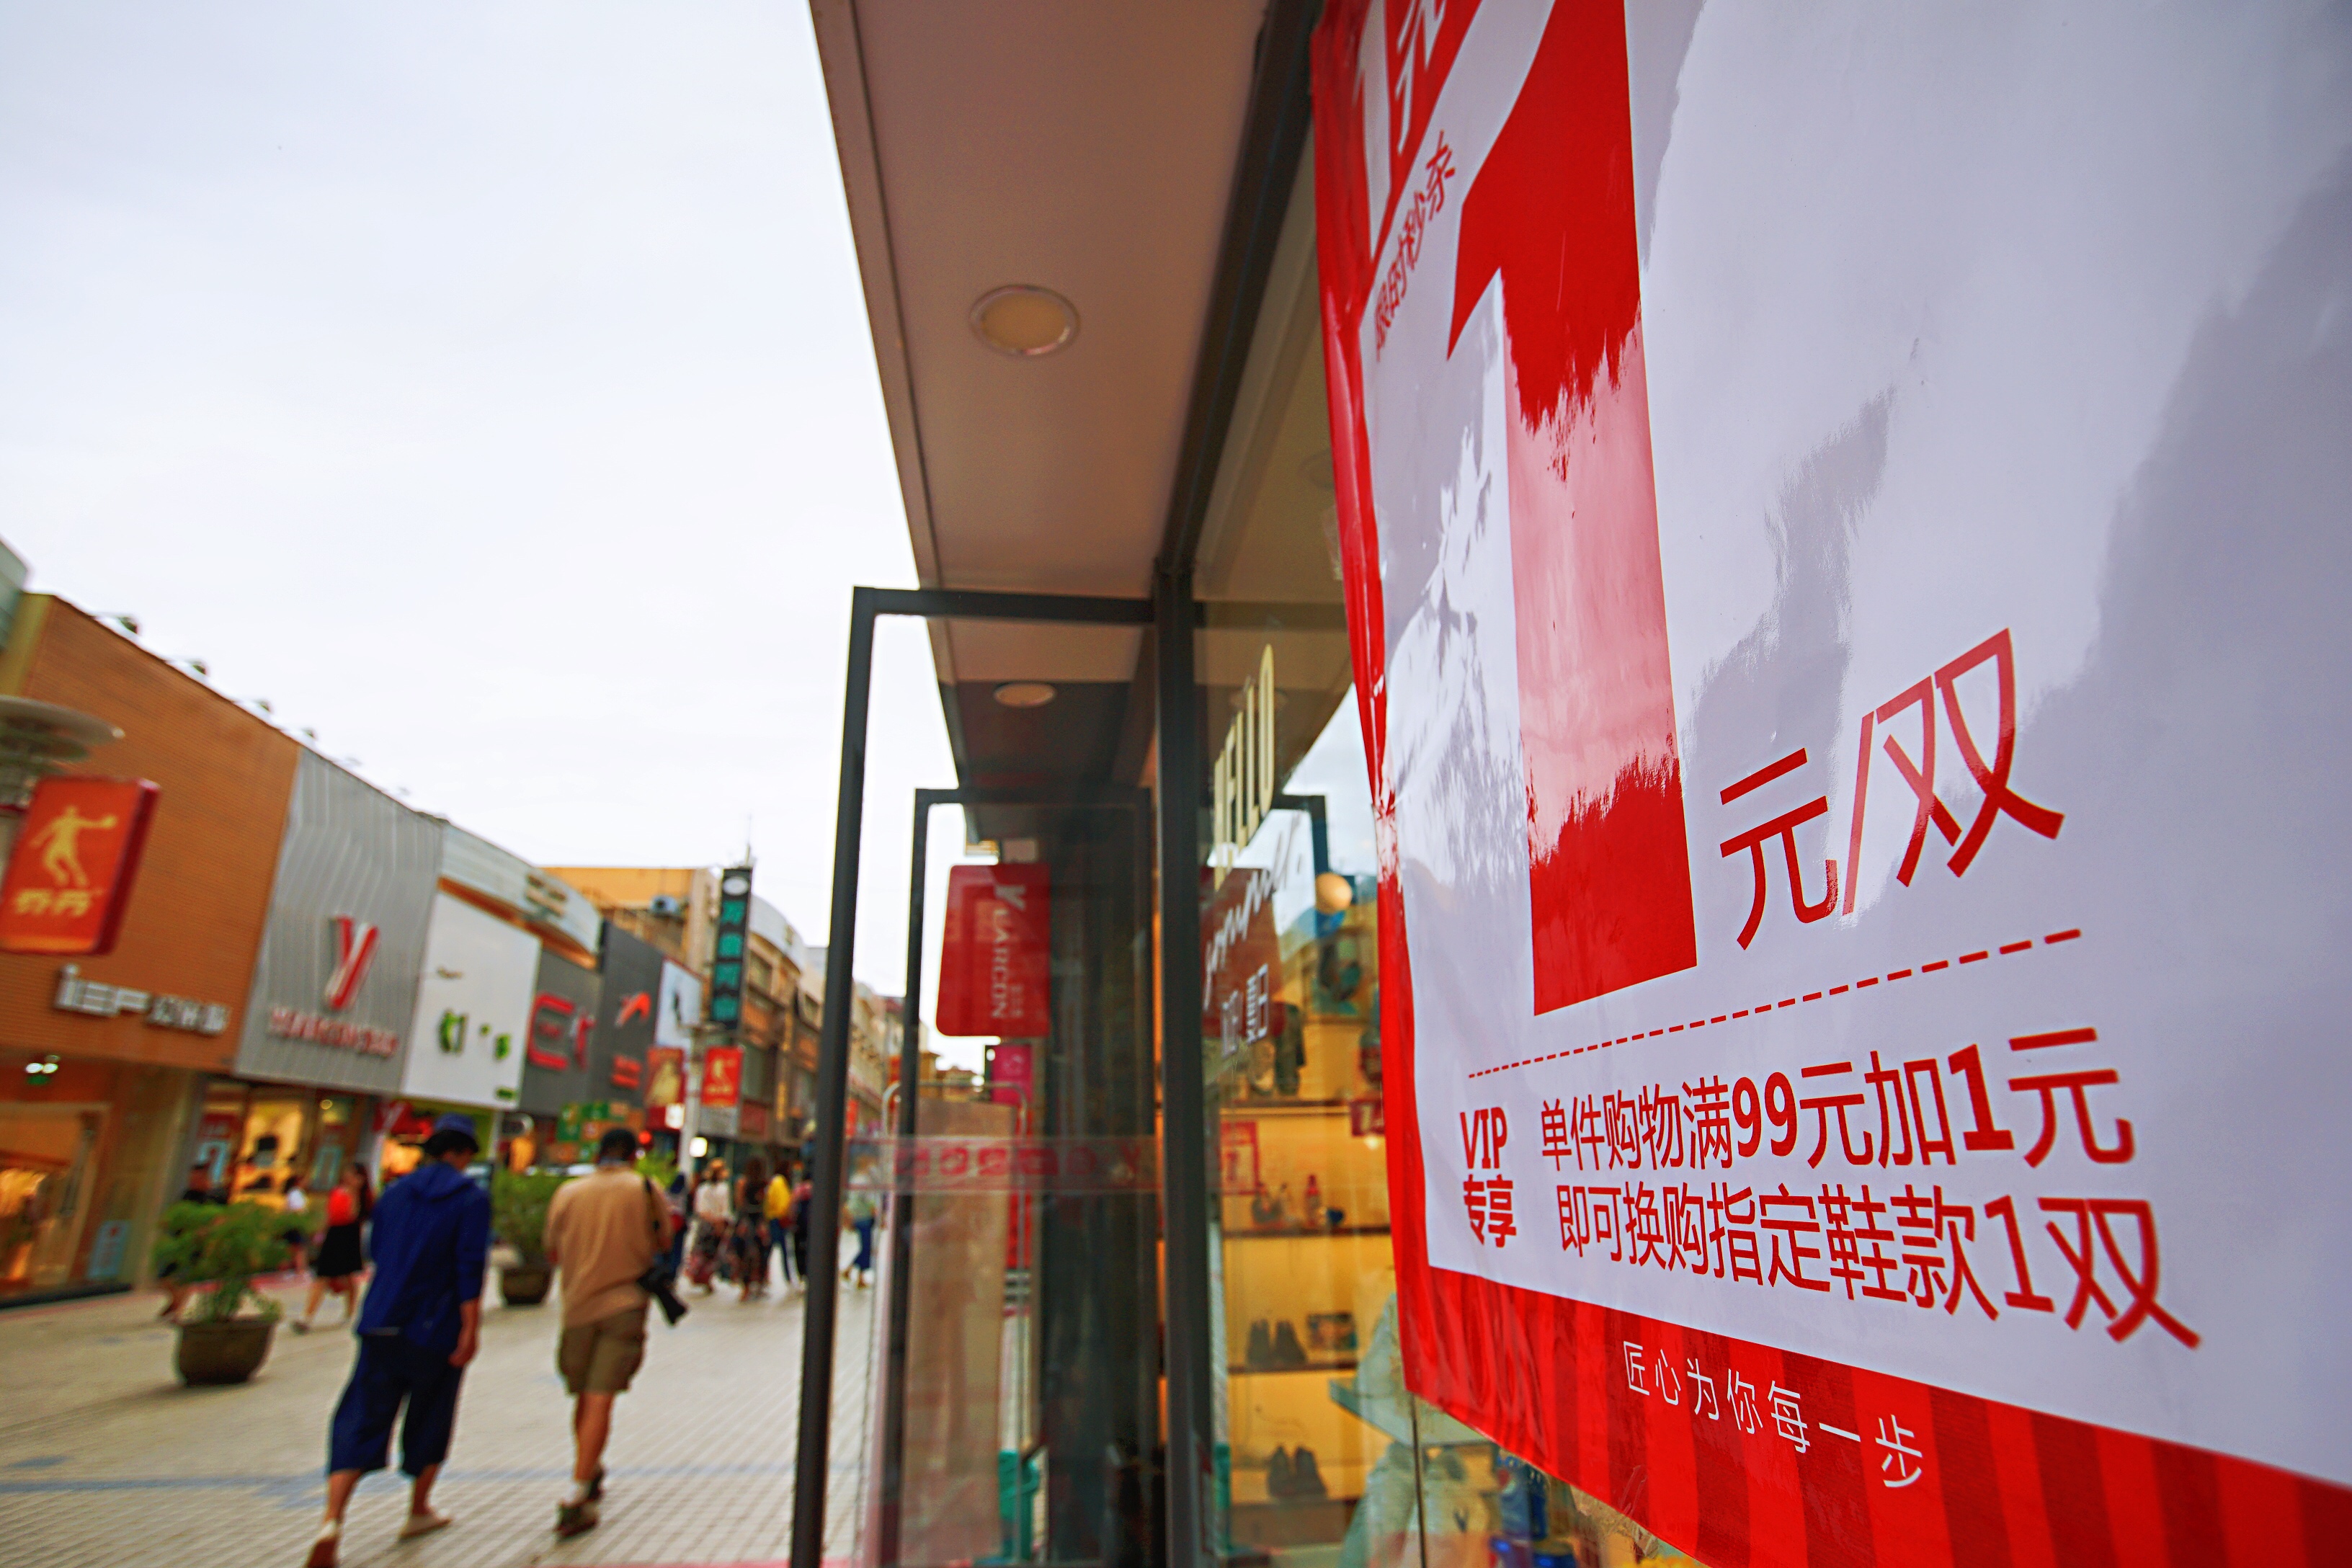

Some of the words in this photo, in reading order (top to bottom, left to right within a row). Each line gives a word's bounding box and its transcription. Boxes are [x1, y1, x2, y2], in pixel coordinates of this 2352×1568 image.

[1460, 1107, 1507, 1170] VIP
[1541, 1027, 2136, 1171] 单件购物满99元加1元
[1463, 1173, 1517, 1248] 专享
[1556, 1180, 2201, 1350] 即可换购指定鞋款1双
[1623, 1340, 1923, 1488] 匠心为你每一步
